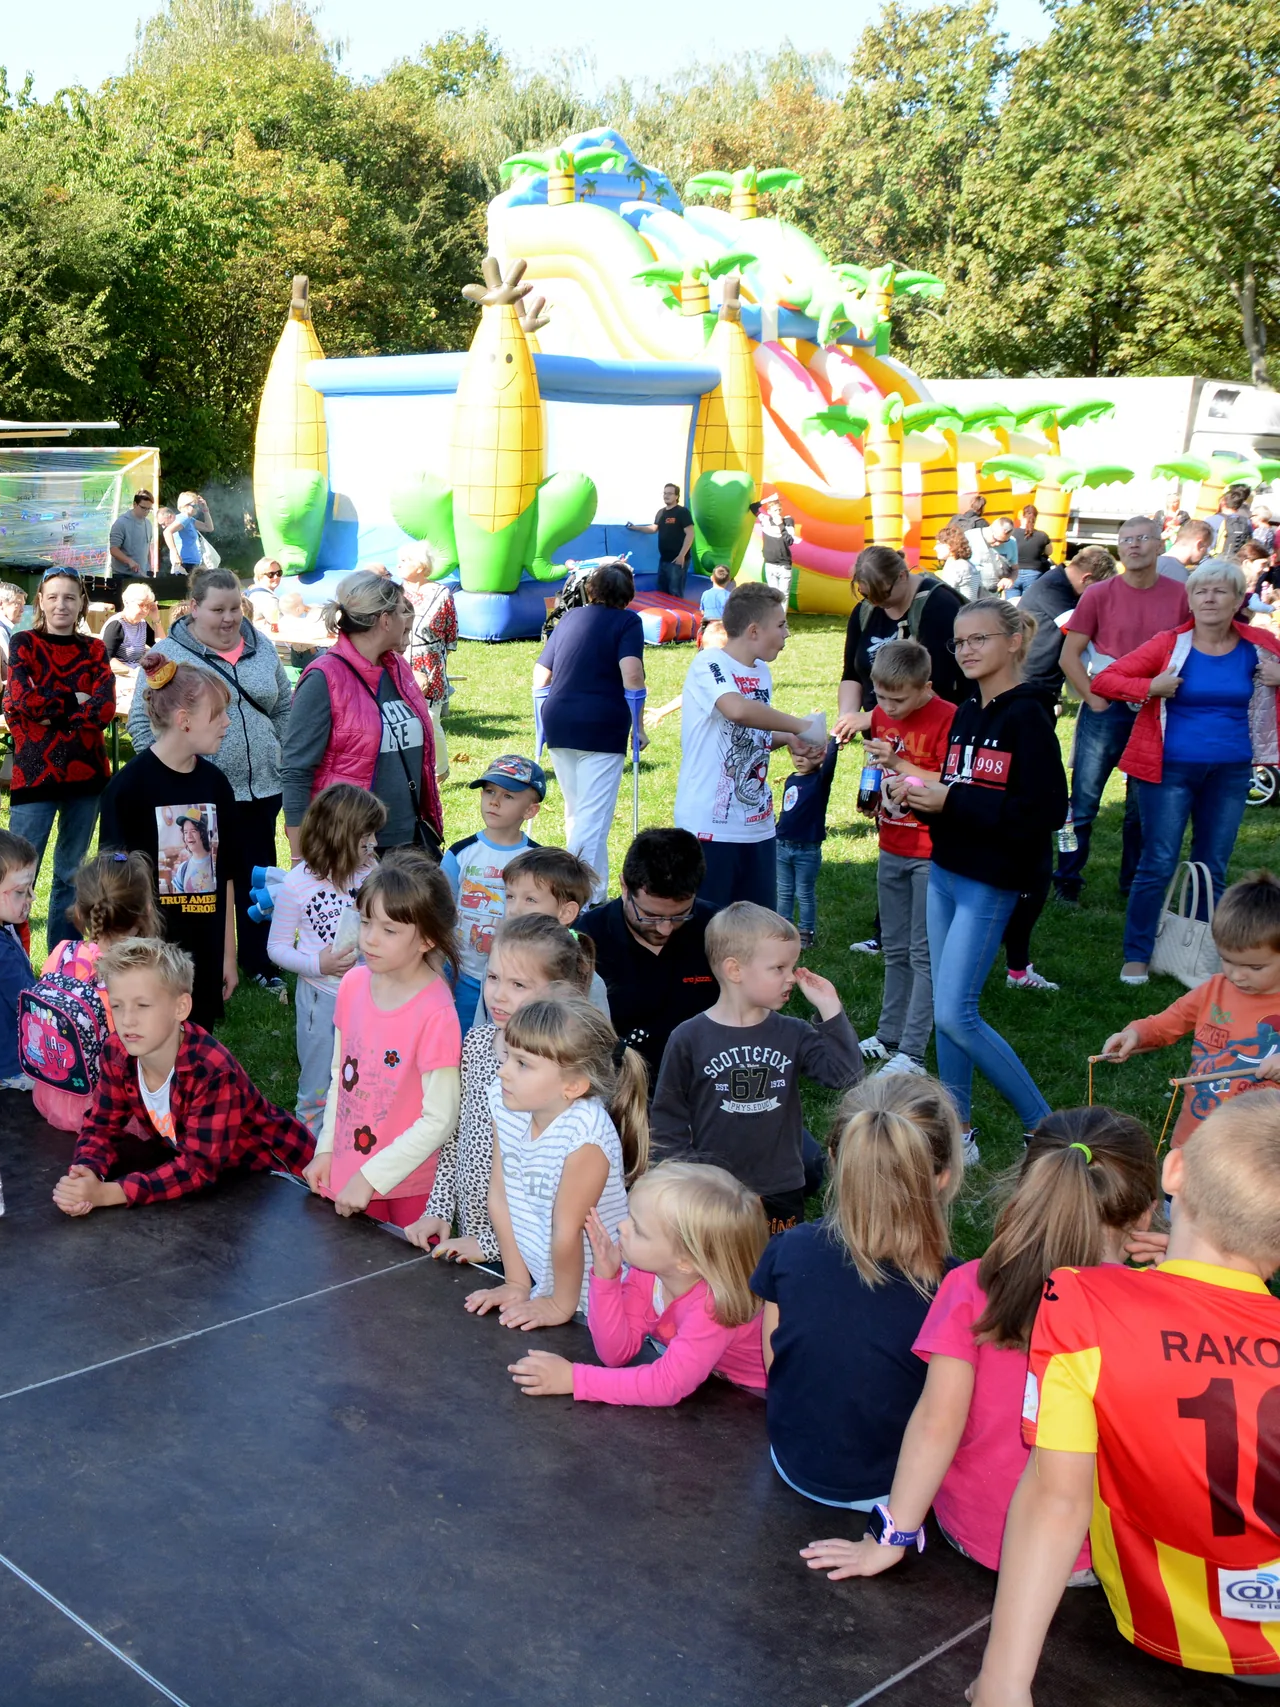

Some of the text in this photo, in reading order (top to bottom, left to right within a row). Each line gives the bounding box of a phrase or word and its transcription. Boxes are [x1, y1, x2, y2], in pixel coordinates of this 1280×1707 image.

[160, 895, 187, 905] TRUE
[30, 1001, 58, 1030] Peppa
[730, 1066, 770, 1101] 67
[770, 1079, 786, 1089] 1973
